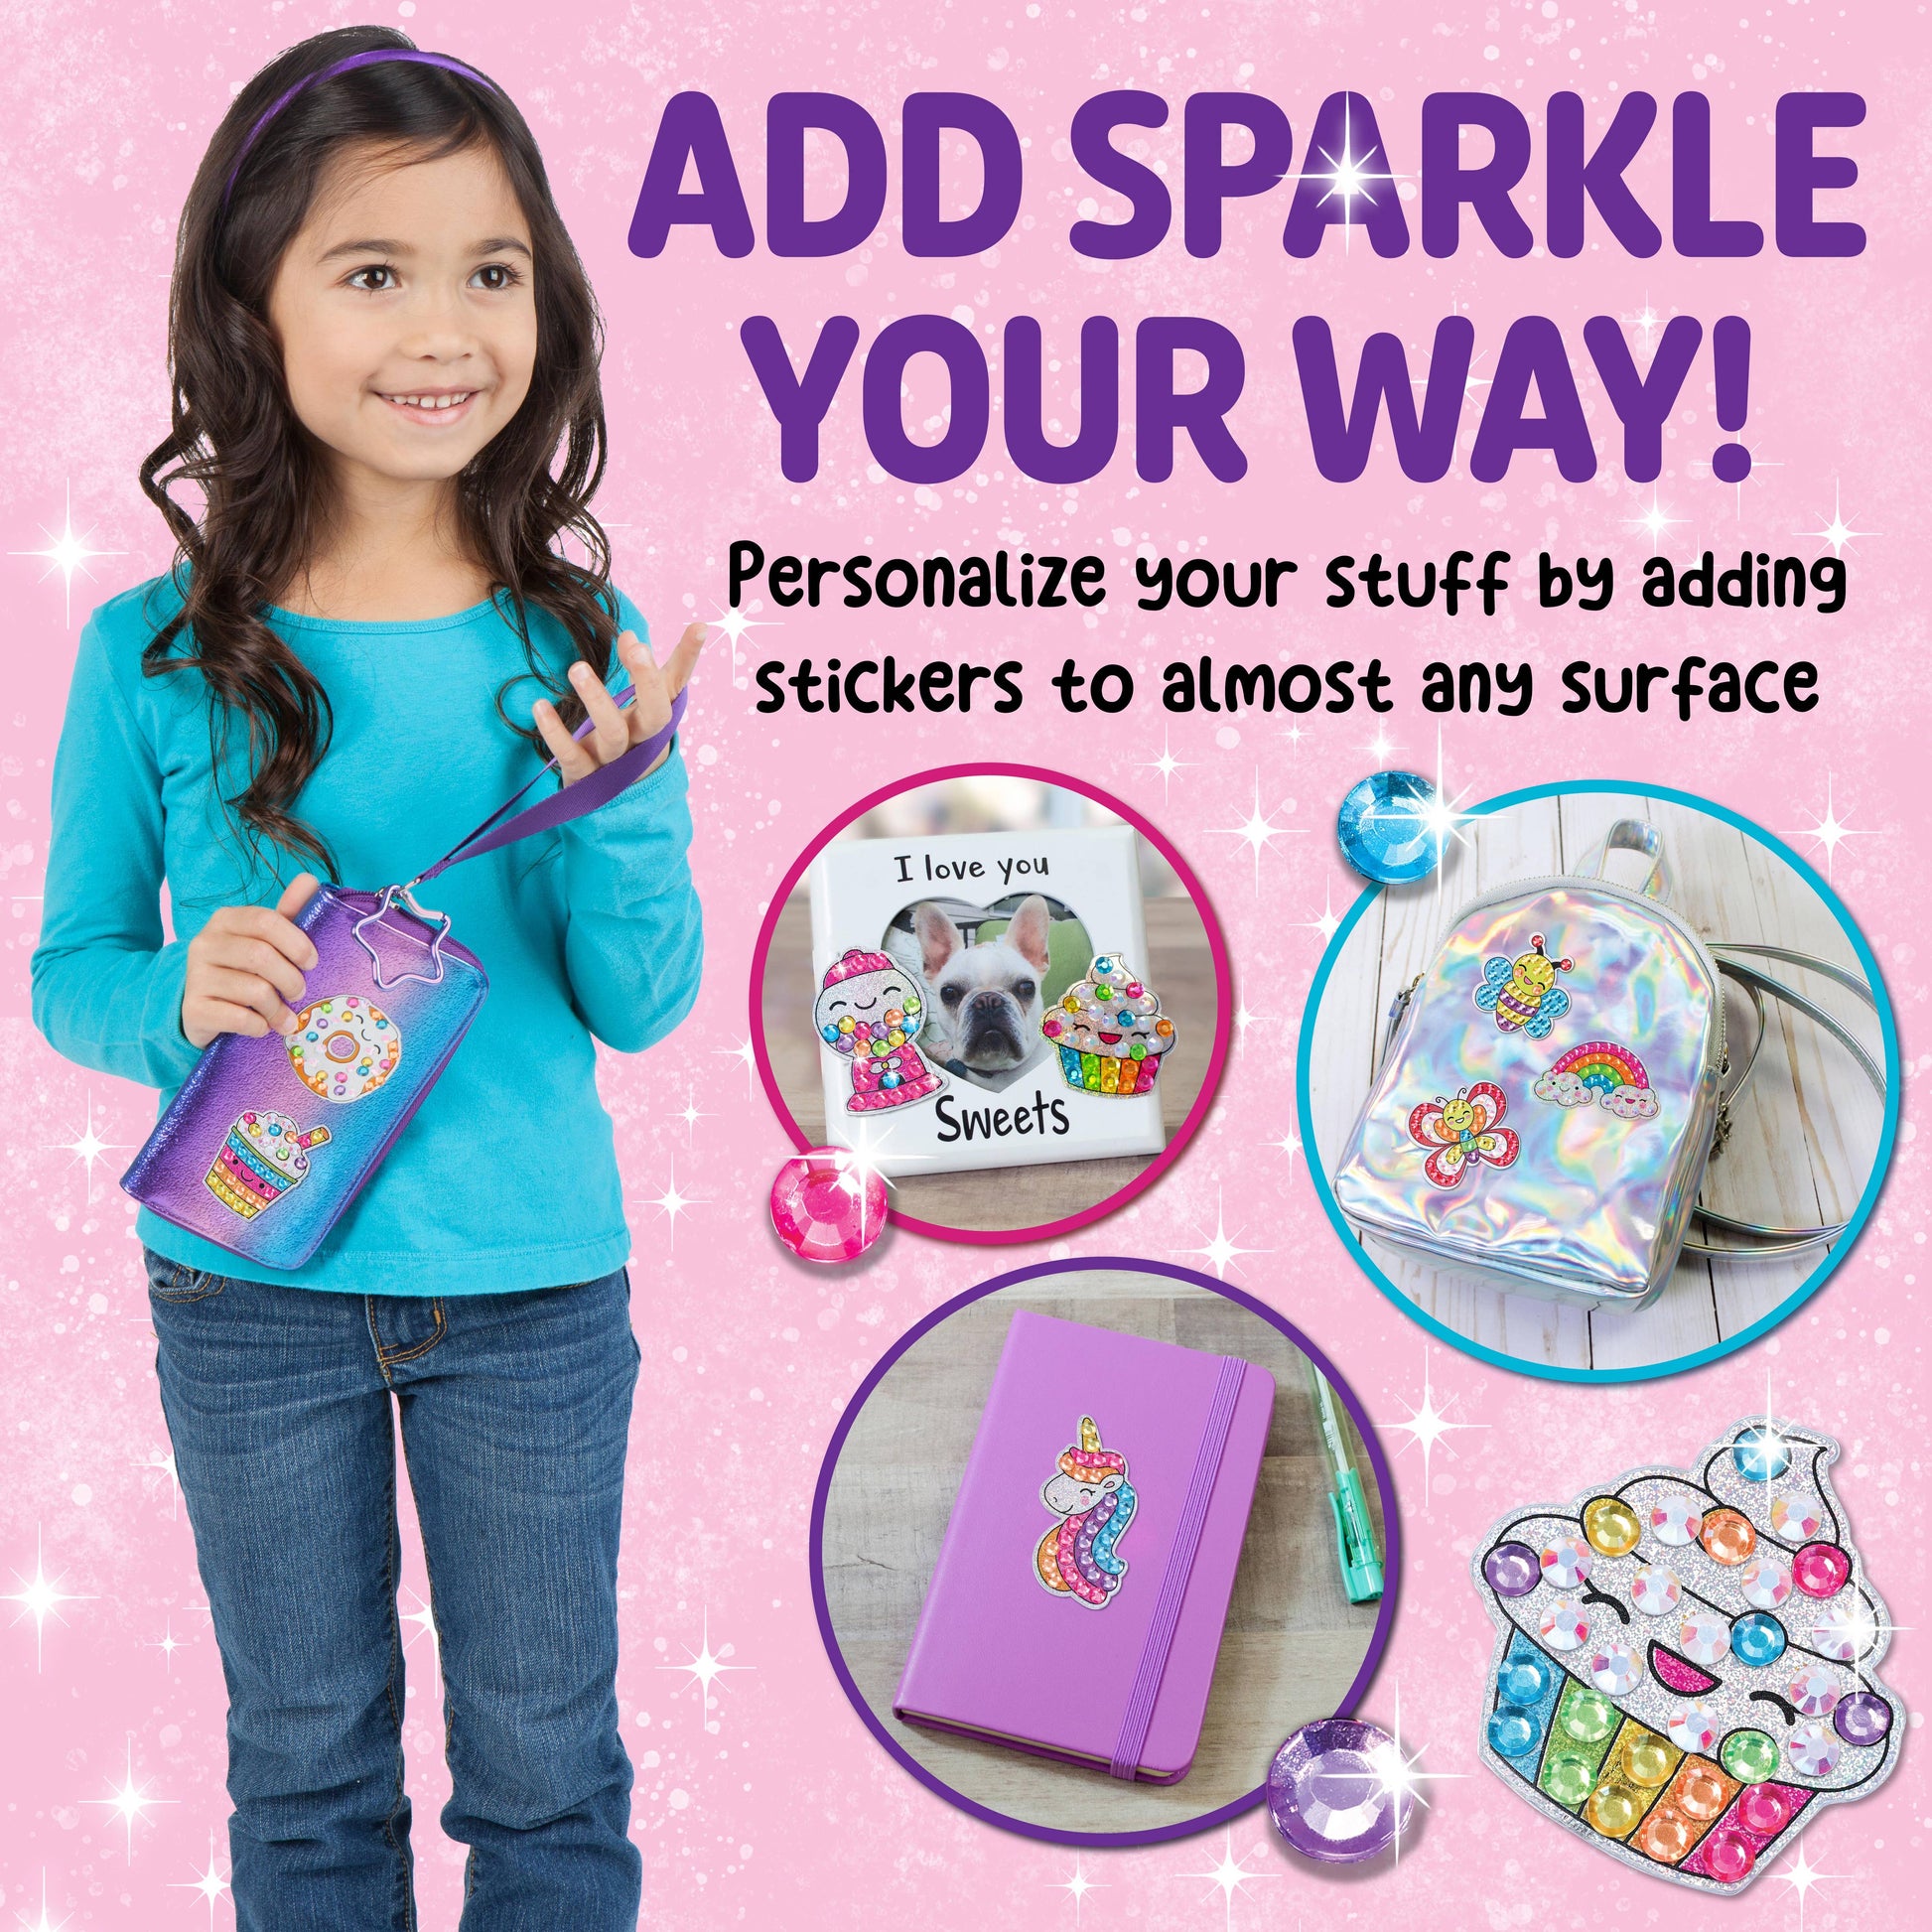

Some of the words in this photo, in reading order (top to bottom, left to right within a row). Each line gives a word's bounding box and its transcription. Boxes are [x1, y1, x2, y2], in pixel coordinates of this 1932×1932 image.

[894, 855, 913, 883] I
[924, 854, 986, 881] love
[997, 857, 1049, 886] you
[935, 1090, 1070, 1143] Sweets
